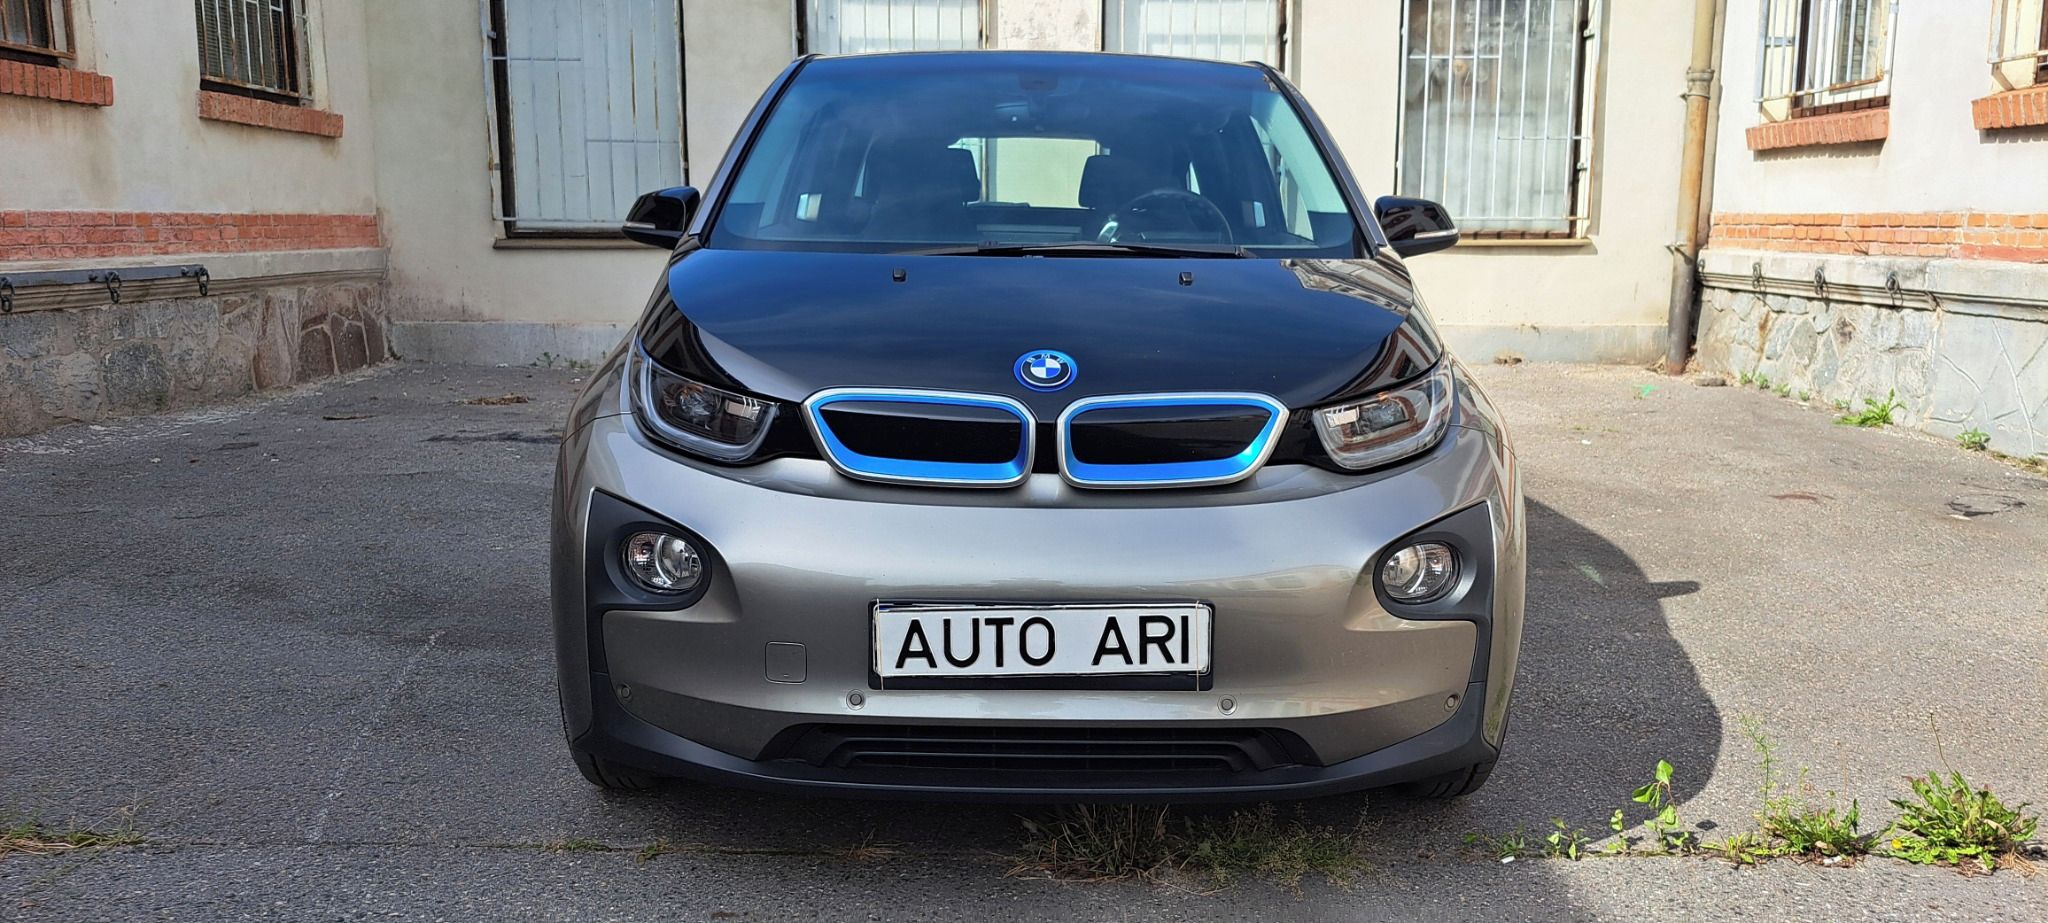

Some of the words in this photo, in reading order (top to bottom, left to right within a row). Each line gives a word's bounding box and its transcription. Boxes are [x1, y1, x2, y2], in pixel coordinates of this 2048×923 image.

[1026, 353, 1065, 363] BMW
[895, 616, 1056, 668] AUTO
[1091, 615, 1189, 666] ARI
